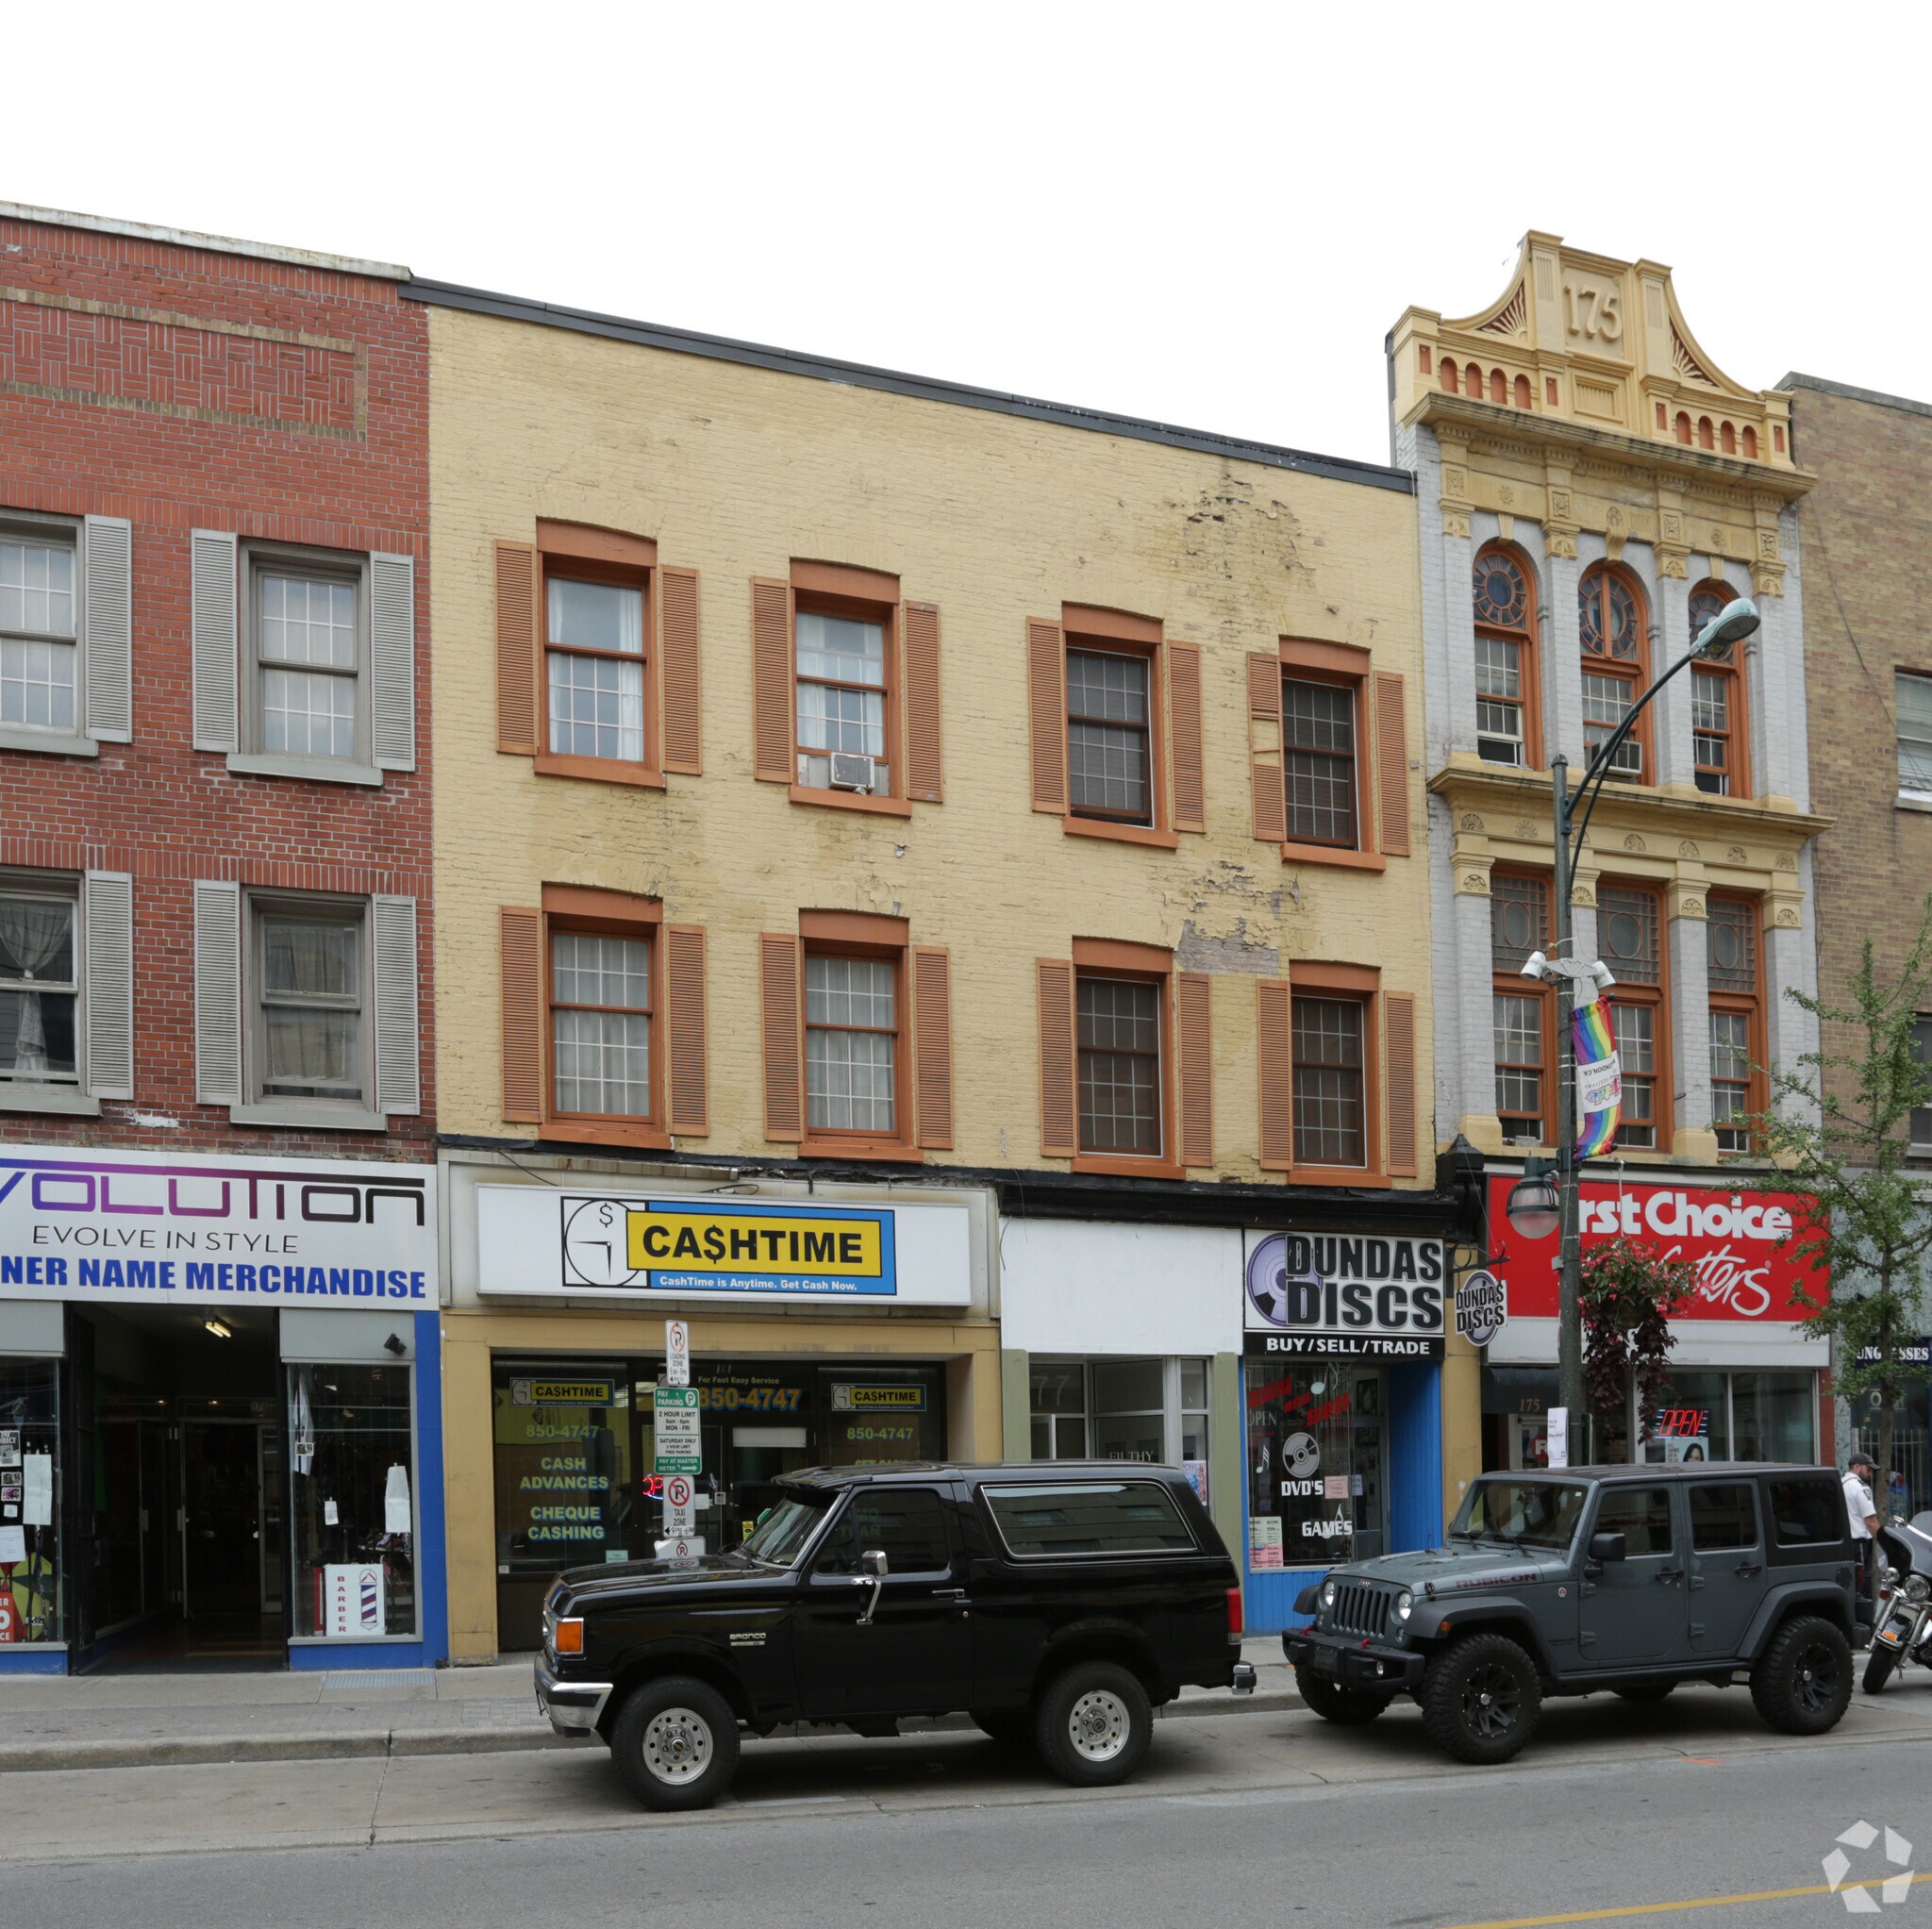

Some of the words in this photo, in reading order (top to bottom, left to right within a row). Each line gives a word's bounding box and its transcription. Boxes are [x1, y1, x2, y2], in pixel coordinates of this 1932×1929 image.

[1564, 284, 1623, 342] 175
[1579, 1192, 1641, 1235] rst
[1644, 1190, 1791, 1239] Choice
[33, 1225, 156, 1248] EVOLVE
[166, 1230, 195, 1249] IN
[206, 1232, 298, 1254] STYLE
[642, 1224, 863, 1264] CA$HTIME
[1286, 1234, 1441, 1283] DUNDAS
[0, 1255, 67, 1286] NER
[78, 1258, 176, 1289] NAME
[186, 1261, 425, 1298] MERCHANDISE
[660, 1276, 714, 1288] CashTime
[717, 1277, 726, 1288] is
[730, 1278, 777, 1289] Anytime.
[780, 1279, 799, 1289] Get
[803, 1280, 828, 1290] Cash
[831, 1281, 857, 1290] Now.
[1456, 1283, 1505, 1310] DUNDAS
[1286, 1280, 1443, 1330] DISCS
[1457, 1306, 1505, 1333] DISCS
[536, 1386, 604, 1398] CA$HTIME
[699, 1387, 802, 1409] 850-4747
[854, 1391, 916, 1403] CA$HTIME
[1520, 1399, 1541, 1412] 175
[1246, 1411, 1277, 1426] OPEN
[1658, 1409, 1704, 1437] OPEN
[526, 1425, 600, 1437] 850-4747
[847, 1427, 914, 1439] 850-4747
[541, 1456, 587, 1471] CASH
[520, 1475, 609, 1490] ADVANCES
[1281, 1480, 1324, 1496] DVD'S
[530, 1505, 602, 1521] CHEQUE
[528, 1525, 605, 1540] CASHING
[1302, 1521, 1353, 1537] GAMES
[1456, 1572, 1538, 1588] RUBICON
[337, 1575, 346, 1633] BARBER
